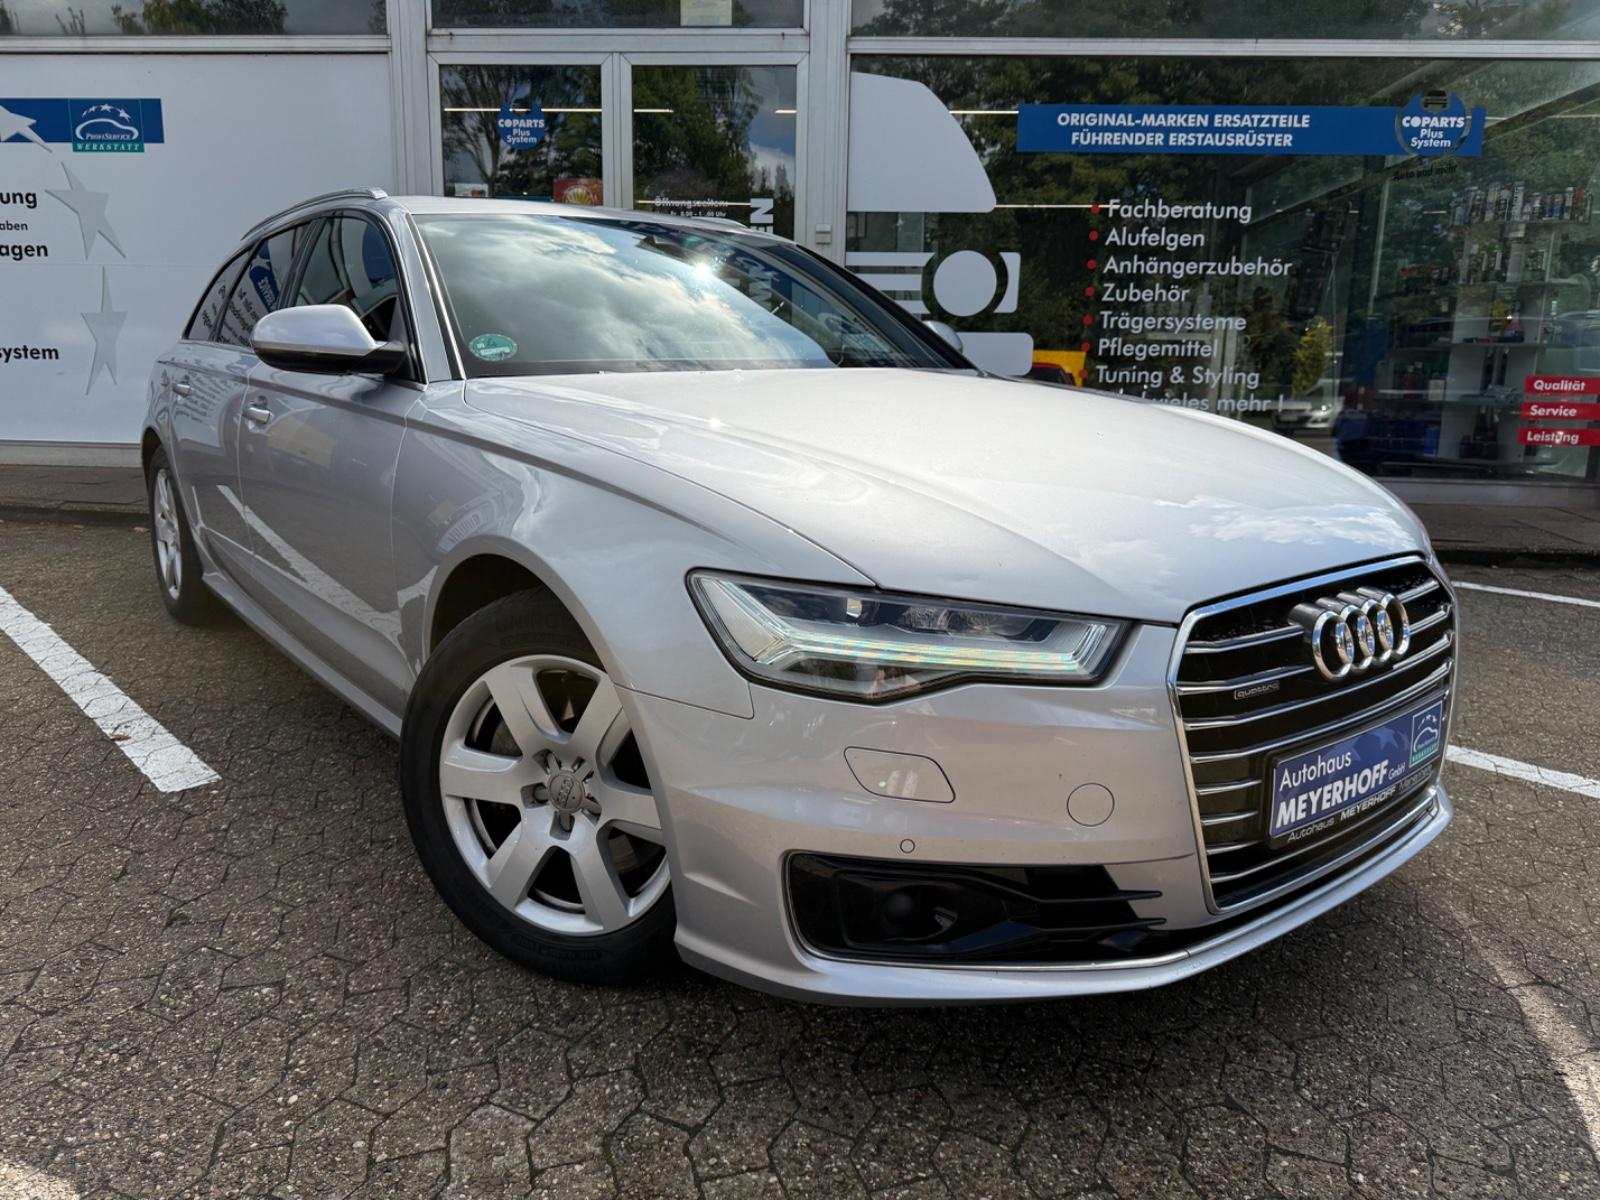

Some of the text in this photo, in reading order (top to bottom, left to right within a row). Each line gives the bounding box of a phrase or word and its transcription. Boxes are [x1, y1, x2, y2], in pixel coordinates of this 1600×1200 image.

[498, 118, 545, 128] COPARTS
[1057, 113, 1310, 128] ORIGINAL-MARKEN ERSATZTEILE
[1402, 115, 1465, 128] COPARTS
[506, 135, 537, 145] System
[512, 128, 531, 136] Plus
[1071, 130, 1293, 147] FÜHRENDER ERSTAUSRÜSTER
[1420, 128, 1444, 139] Plus
[77, 143, 139, 151] WERKSTATT
[1411, 137, 1451, 149] System
[0, 192, 37, 209] ung
[1107, 199, 1252, 223] Fachberatung
[1105, 227, 1205, 250] Alufelgen
[0, 244, 48, 261] agen
[1103, 255, 1292, 278] Anhängerzubehör
[1101, 283, 1189, 302] Zubehör
[1100, 310, 1247, 334] Trägersysteme
[0, 345, 59, 363] ystem
[1098, 338, 1218, 361] Pflegemittel
[1096, 365, 1260, 389] Tuning & Styling
[1533, 380, 1586, 392] Qualität
[1217, 393, 1271, 412] mehr
[1530, 405, 1577, 417] Service
[1527, 431, 1579, 444] Leistung
[1280, 751, 1352, 792] Autohaus
[1275, 760, 1389, 829] MEYERHOFF
[1287, 787, 1396, 843] Autohaus MEYERHOFF
